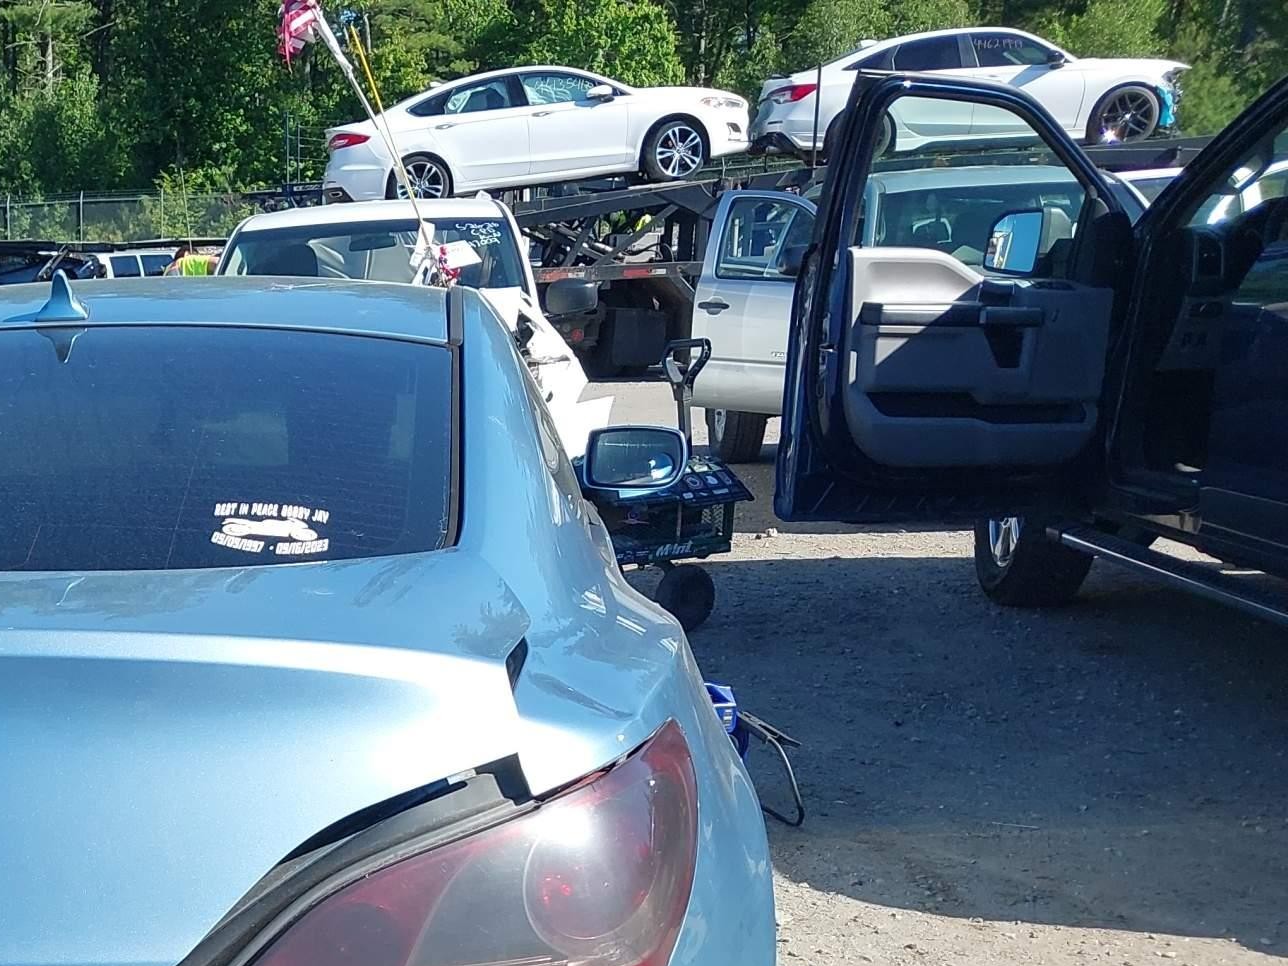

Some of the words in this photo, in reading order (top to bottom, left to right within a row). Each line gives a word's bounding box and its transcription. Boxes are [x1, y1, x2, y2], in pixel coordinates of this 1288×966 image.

[214, 503, 238, 516] REST
[239, 503, 249, 515] IN
[251, 502, 279, 517] PEACE
[312, 509, 329, 524] JAY
